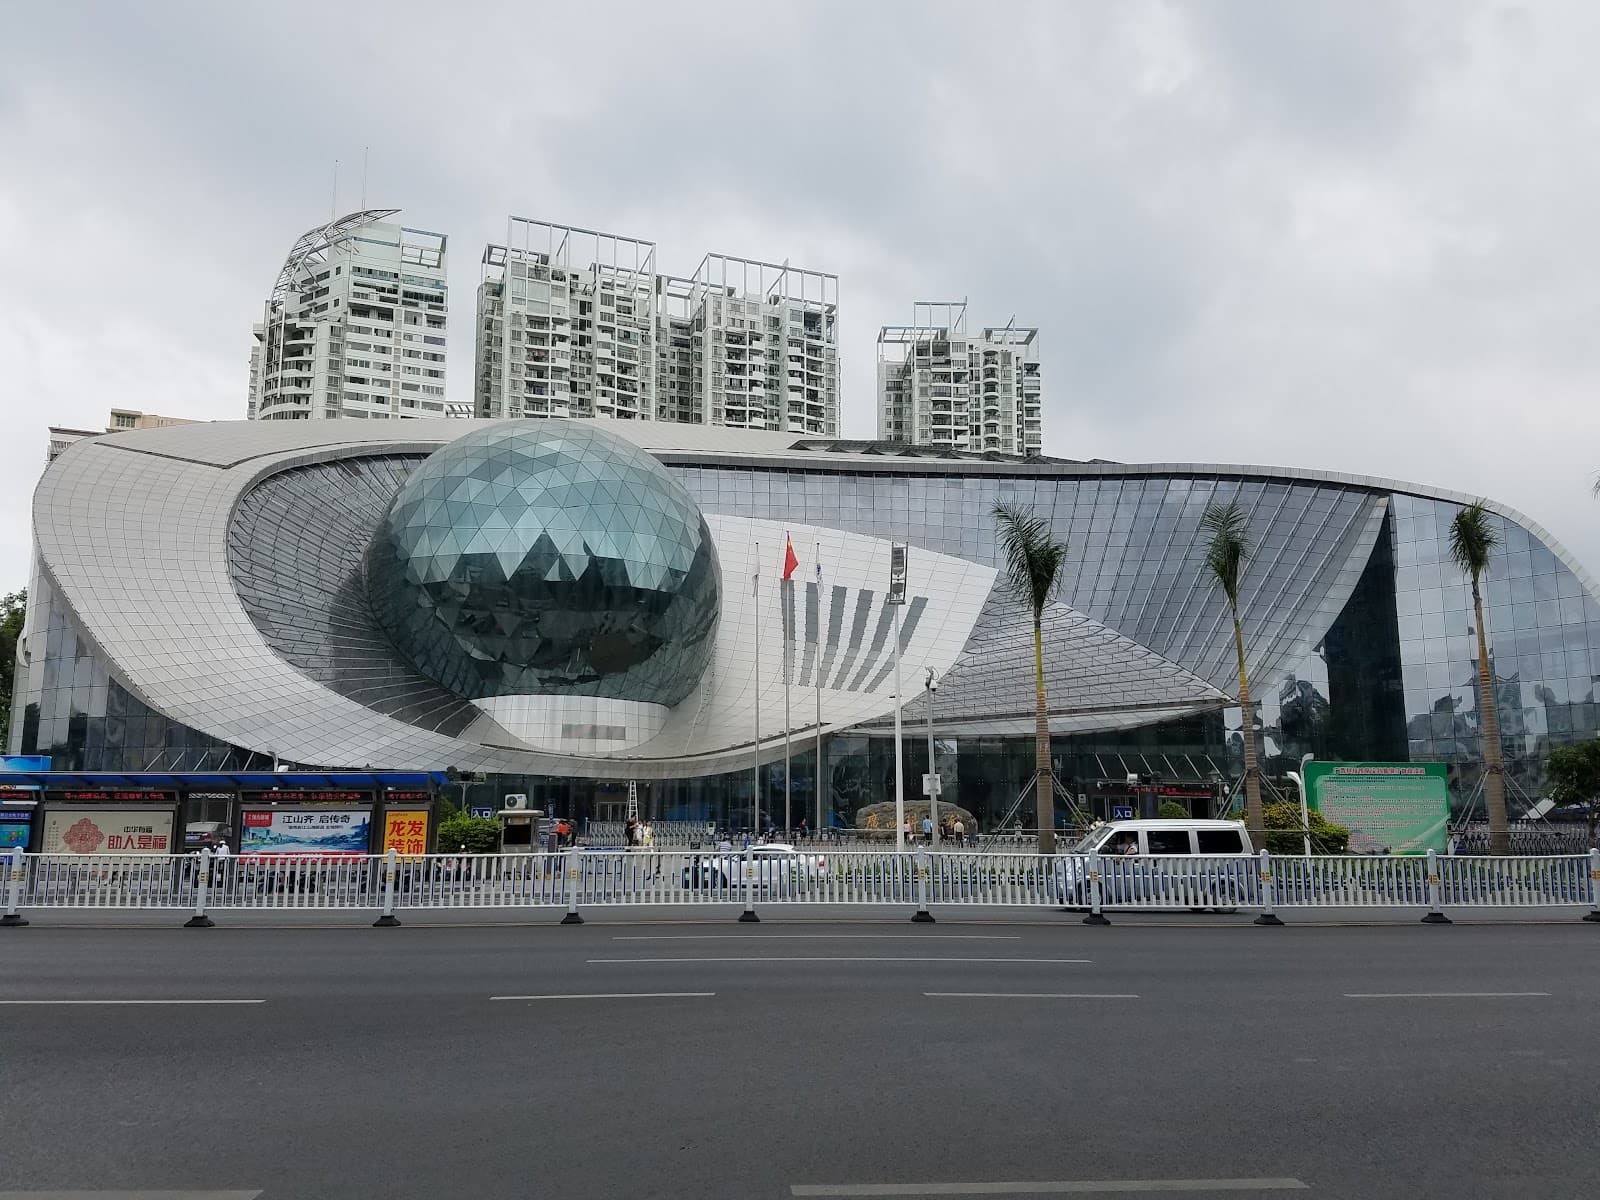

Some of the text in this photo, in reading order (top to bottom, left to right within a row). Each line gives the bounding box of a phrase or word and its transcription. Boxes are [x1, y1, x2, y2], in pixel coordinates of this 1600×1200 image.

[319, 814, 351, 824] 启传奇
[1115, 809, 1132, 818] 入口
[389, 820, 425, 837] 龙发
[107, 834, 167, 850] 助人是福
[388, 838, 424, 854] 装饰
